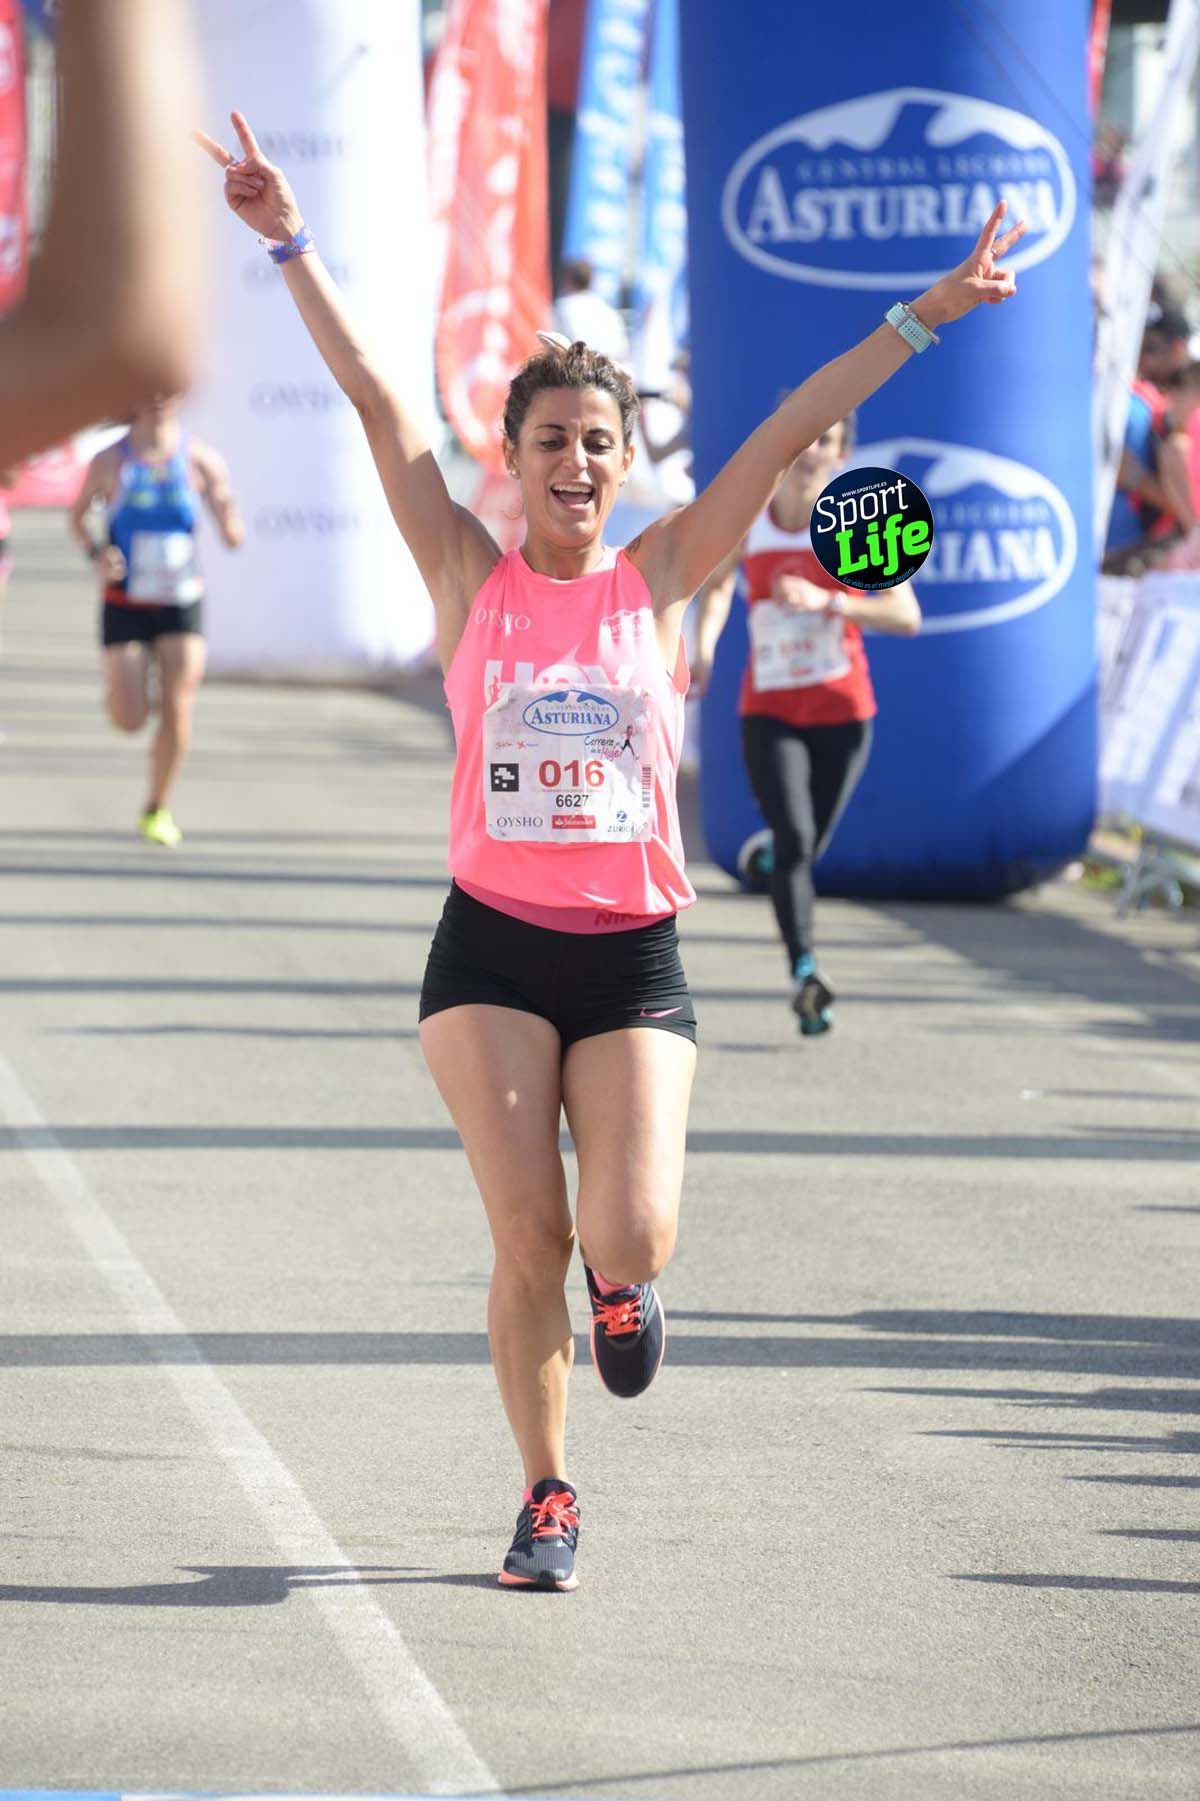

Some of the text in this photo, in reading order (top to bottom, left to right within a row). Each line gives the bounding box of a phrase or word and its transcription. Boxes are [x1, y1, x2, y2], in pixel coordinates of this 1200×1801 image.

[531, 707, 611, 725] ASTURIANA
[539, 759, 605, 787] 016
[556, 794, 589, 808] 6627
[496, 816, 544, 828] OYSHO
